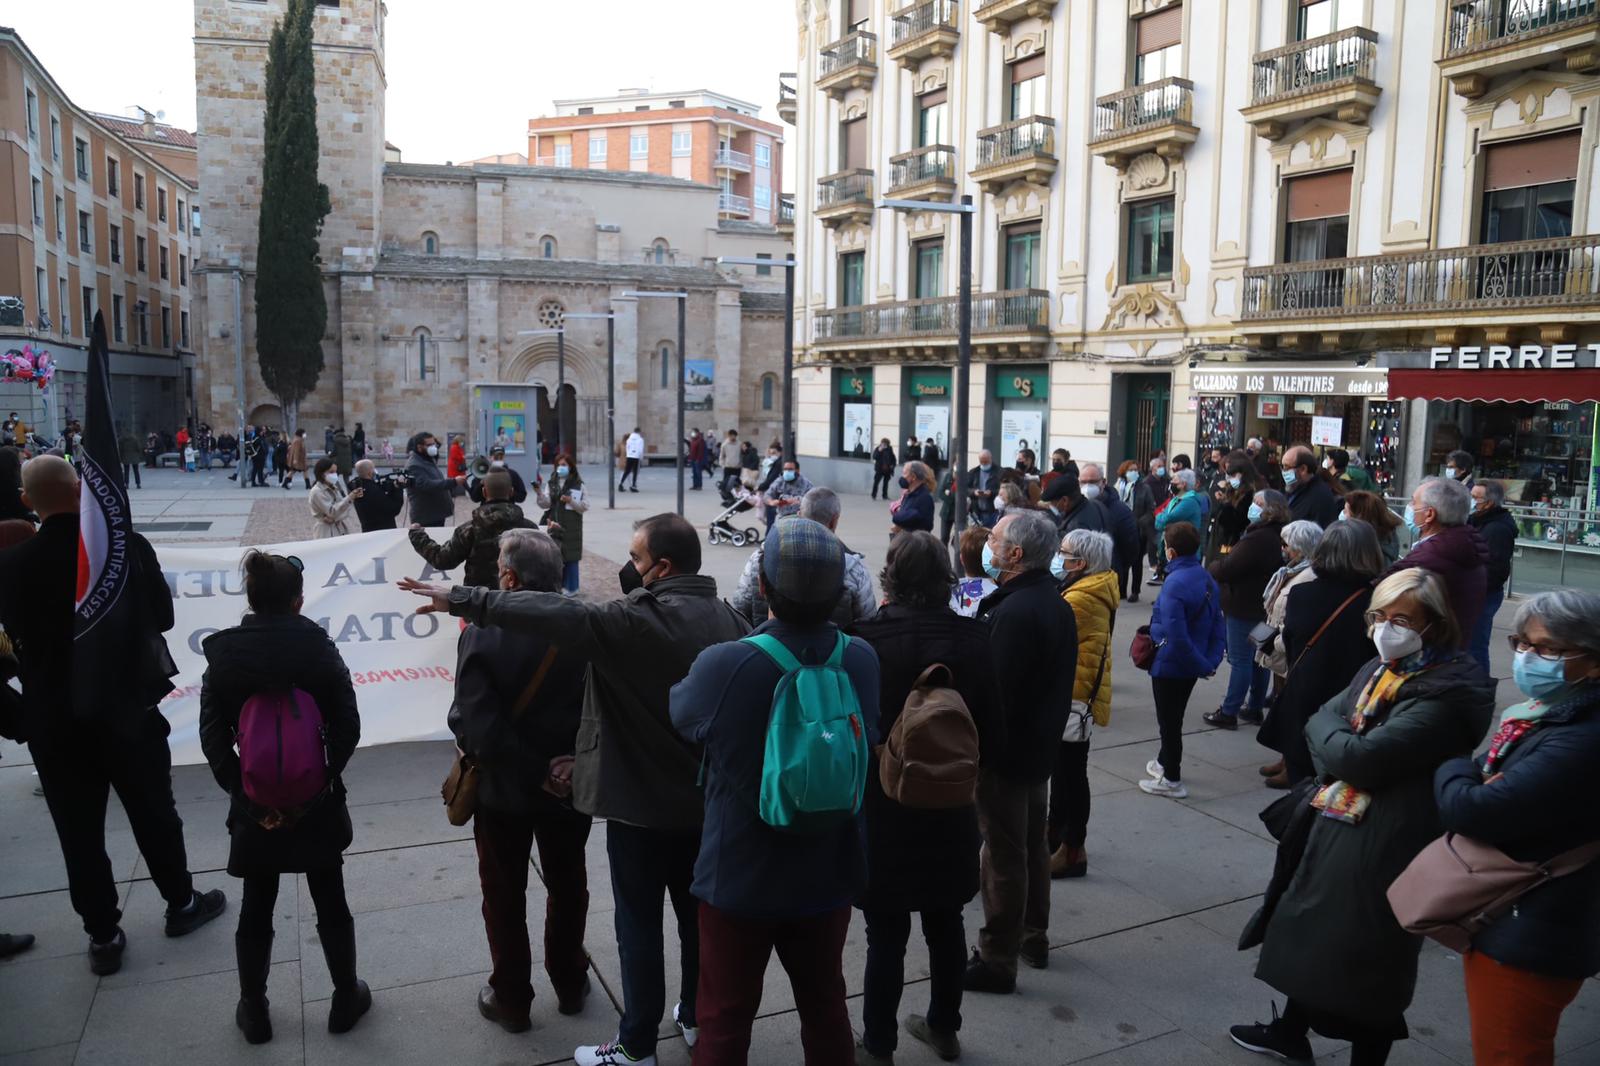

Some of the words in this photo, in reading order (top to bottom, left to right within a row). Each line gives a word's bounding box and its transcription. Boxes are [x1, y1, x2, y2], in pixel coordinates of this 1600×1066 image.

[1193, 375, 1238, 391] CALZADOS
[1246, 375, 1264, 391] LOS
[1272, 376, 1334, 393] VALENTINES
[1348, 380, 1372, 393] desde
[81, 530, 126, 619] ANTIFASCISTA
